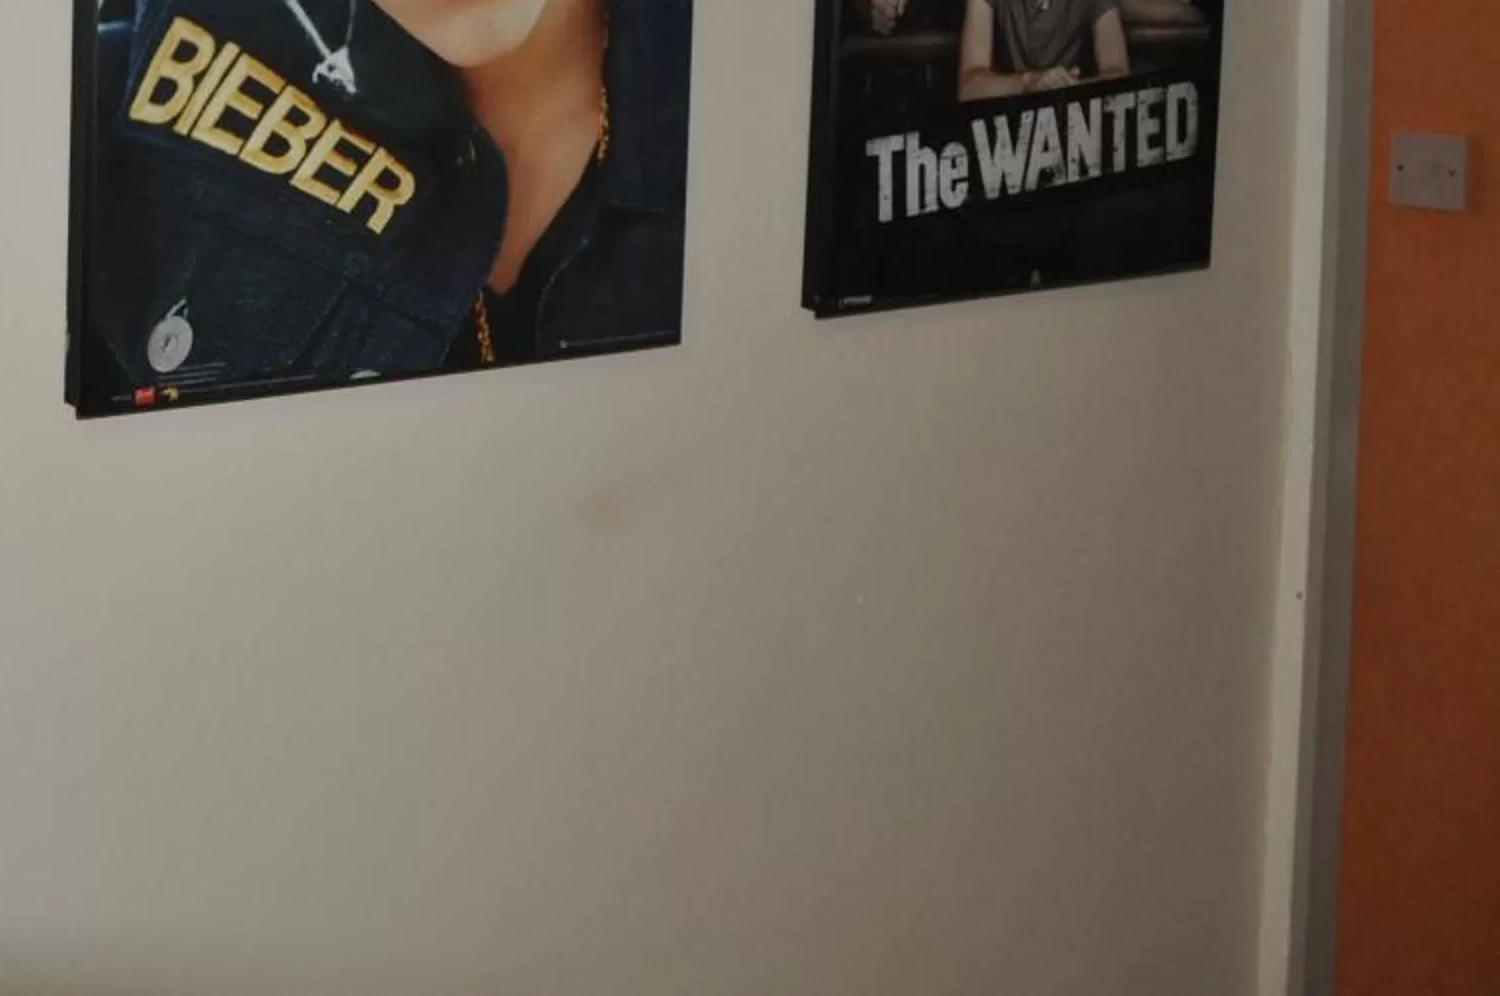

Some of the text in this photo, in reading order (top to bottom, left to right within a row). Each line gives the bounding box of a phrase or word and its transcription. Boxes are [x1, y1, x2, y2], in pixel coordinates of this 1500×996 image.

[128, 15, 417, 235] BIEBER
[865, 80, 1200, 224] The WANTED
